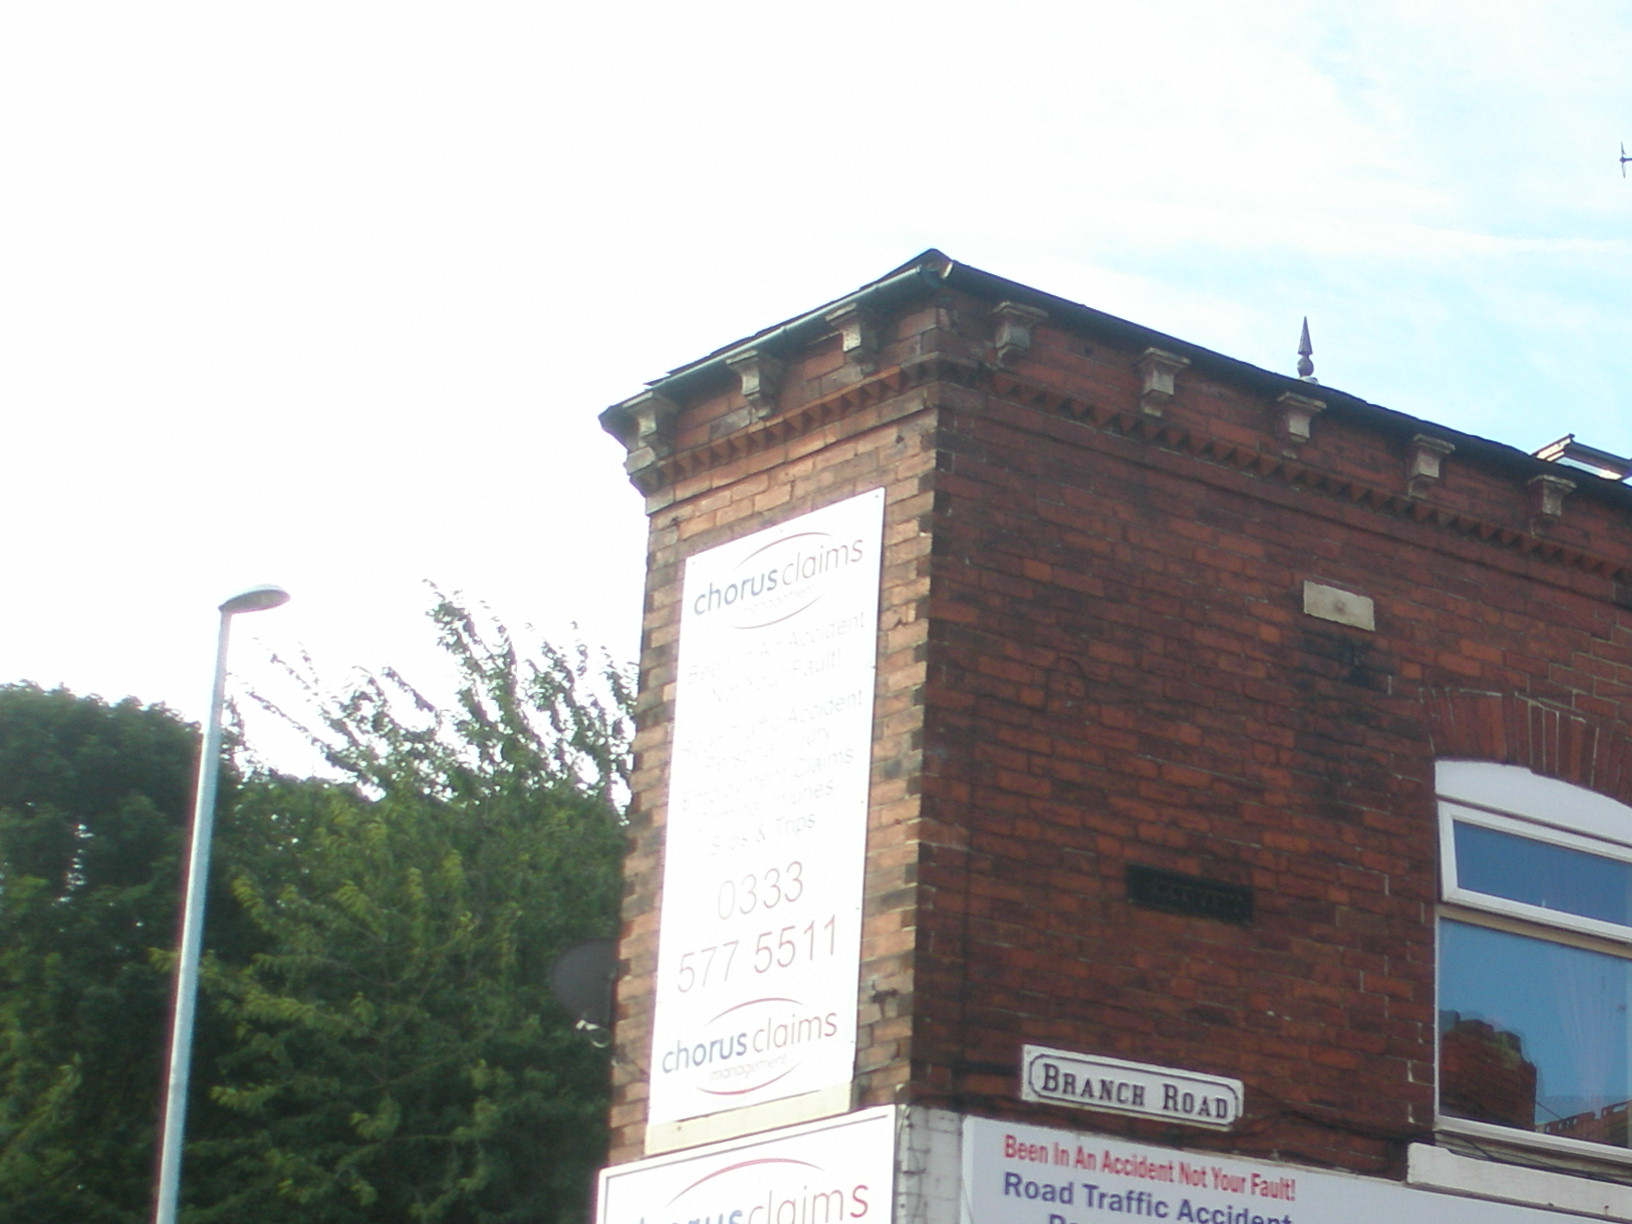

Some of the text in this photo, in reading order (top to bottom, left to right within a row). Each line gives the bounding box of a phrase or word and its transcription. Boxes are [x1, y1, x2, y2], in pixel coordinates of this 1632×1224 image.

[693, 537, 865, 617] chorusclaims
[717, 860, 805, 921] 0333
[676, 912, 837, 995] 577 5511
[661, 1011, 839, 1075] chorusclaims
[1004, 1134, 1297, 1202] Been In An Accident Not Your Fault!
[1004, 1172, 1074, 1206] Road
[1083, 1183, 1169, 1220] Traffic
